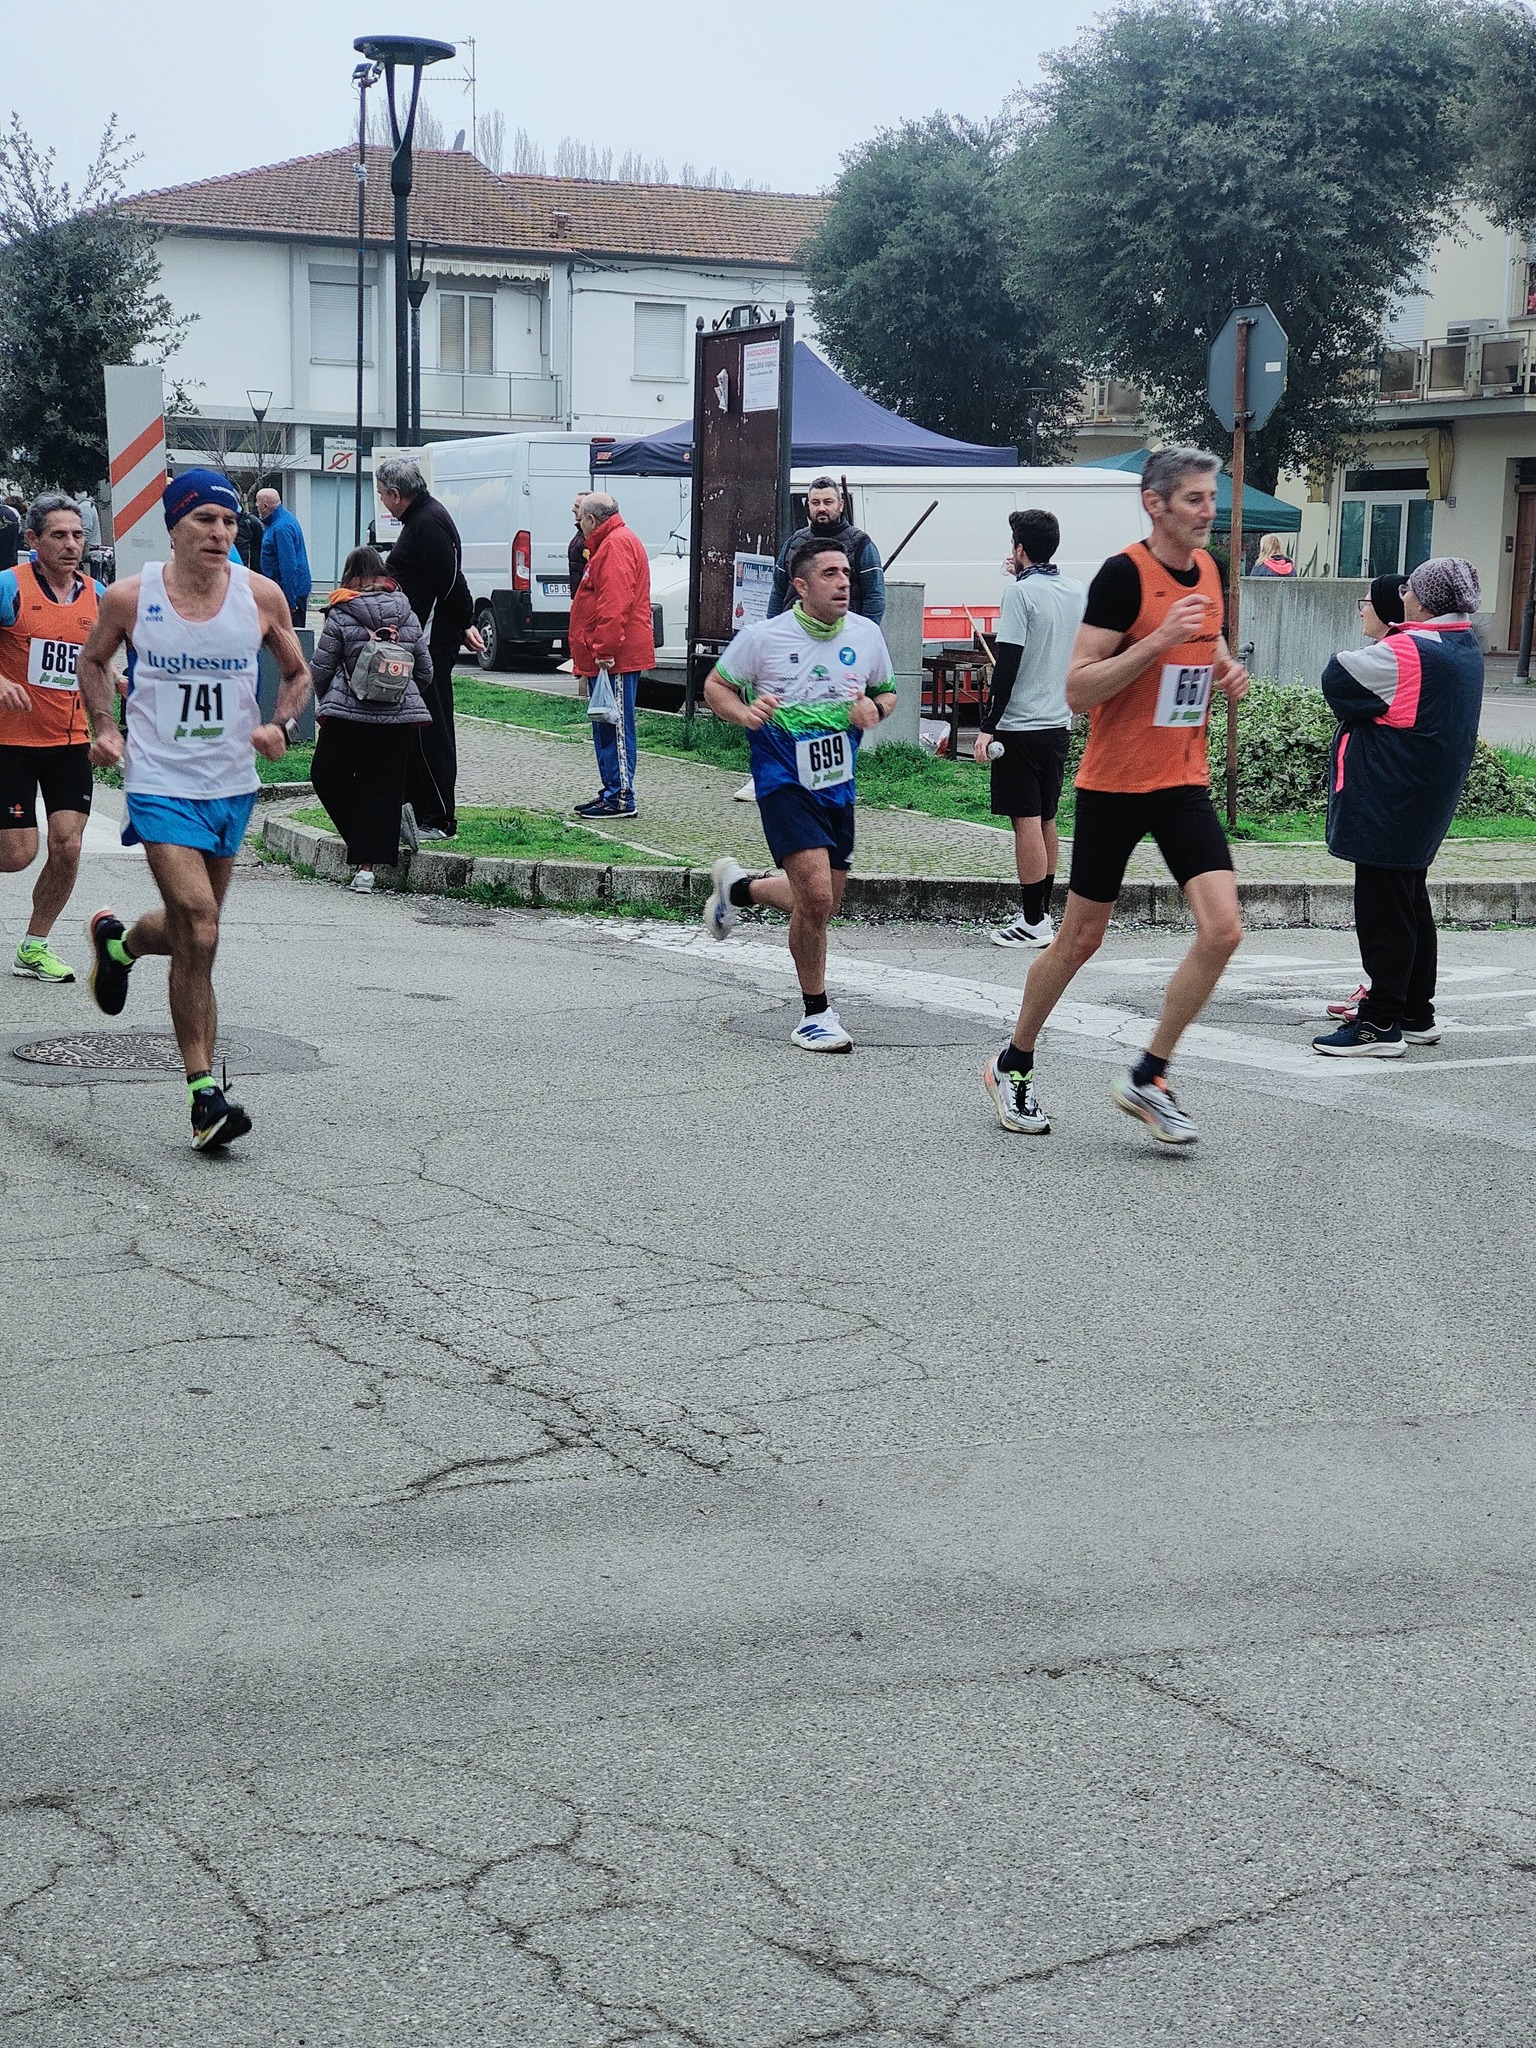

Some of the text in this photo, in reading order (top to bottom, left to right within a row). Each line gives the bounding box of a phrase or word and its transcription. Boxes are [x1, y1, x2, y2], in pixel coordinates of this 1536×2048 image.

[41, 641, 79, 674] 685
[147, 650, 248, 674] lughesina
[178, 683, 223, 722] 741
[809, 735, 844, 772] 699
